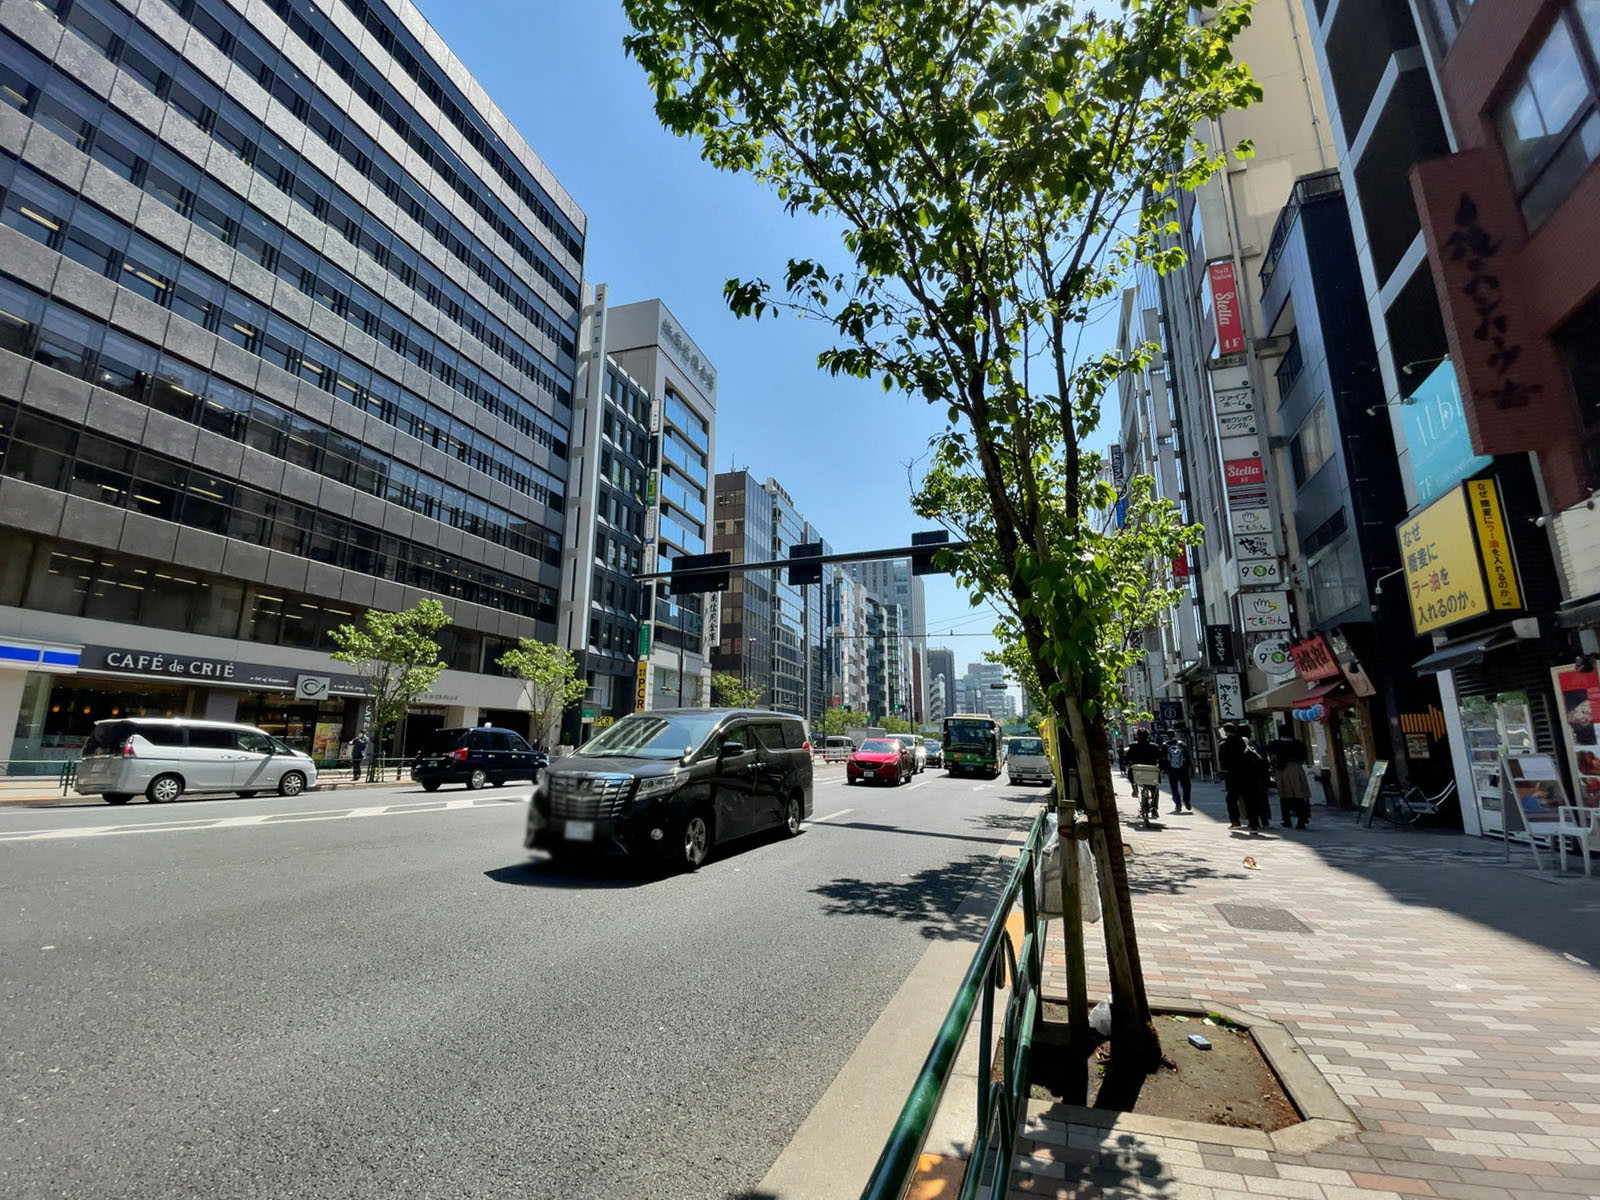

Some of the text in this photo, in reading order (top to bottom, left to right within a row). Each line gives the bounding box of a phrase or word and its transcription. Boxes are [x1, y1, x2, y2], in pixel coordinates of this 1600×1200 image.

[1215, 292, 1234, 326] Stella
[1227, 465, 1260, 478] Stella
[1403, 522, 1421, 548] なぜ
[1406, 542, 1439, 575] 蕎麦に
[1411, 567, 1450, 598] ラー油を
[1247, 616, 1287, 626] てもみん
[1418, 590, 1475, 626] 入れるのか。
[107, 652, 234, 678] CAFÉ de CRIÉ
[637, 678, 646, 709] PCR
[1219, 683, 1235, 717] やすべえ
